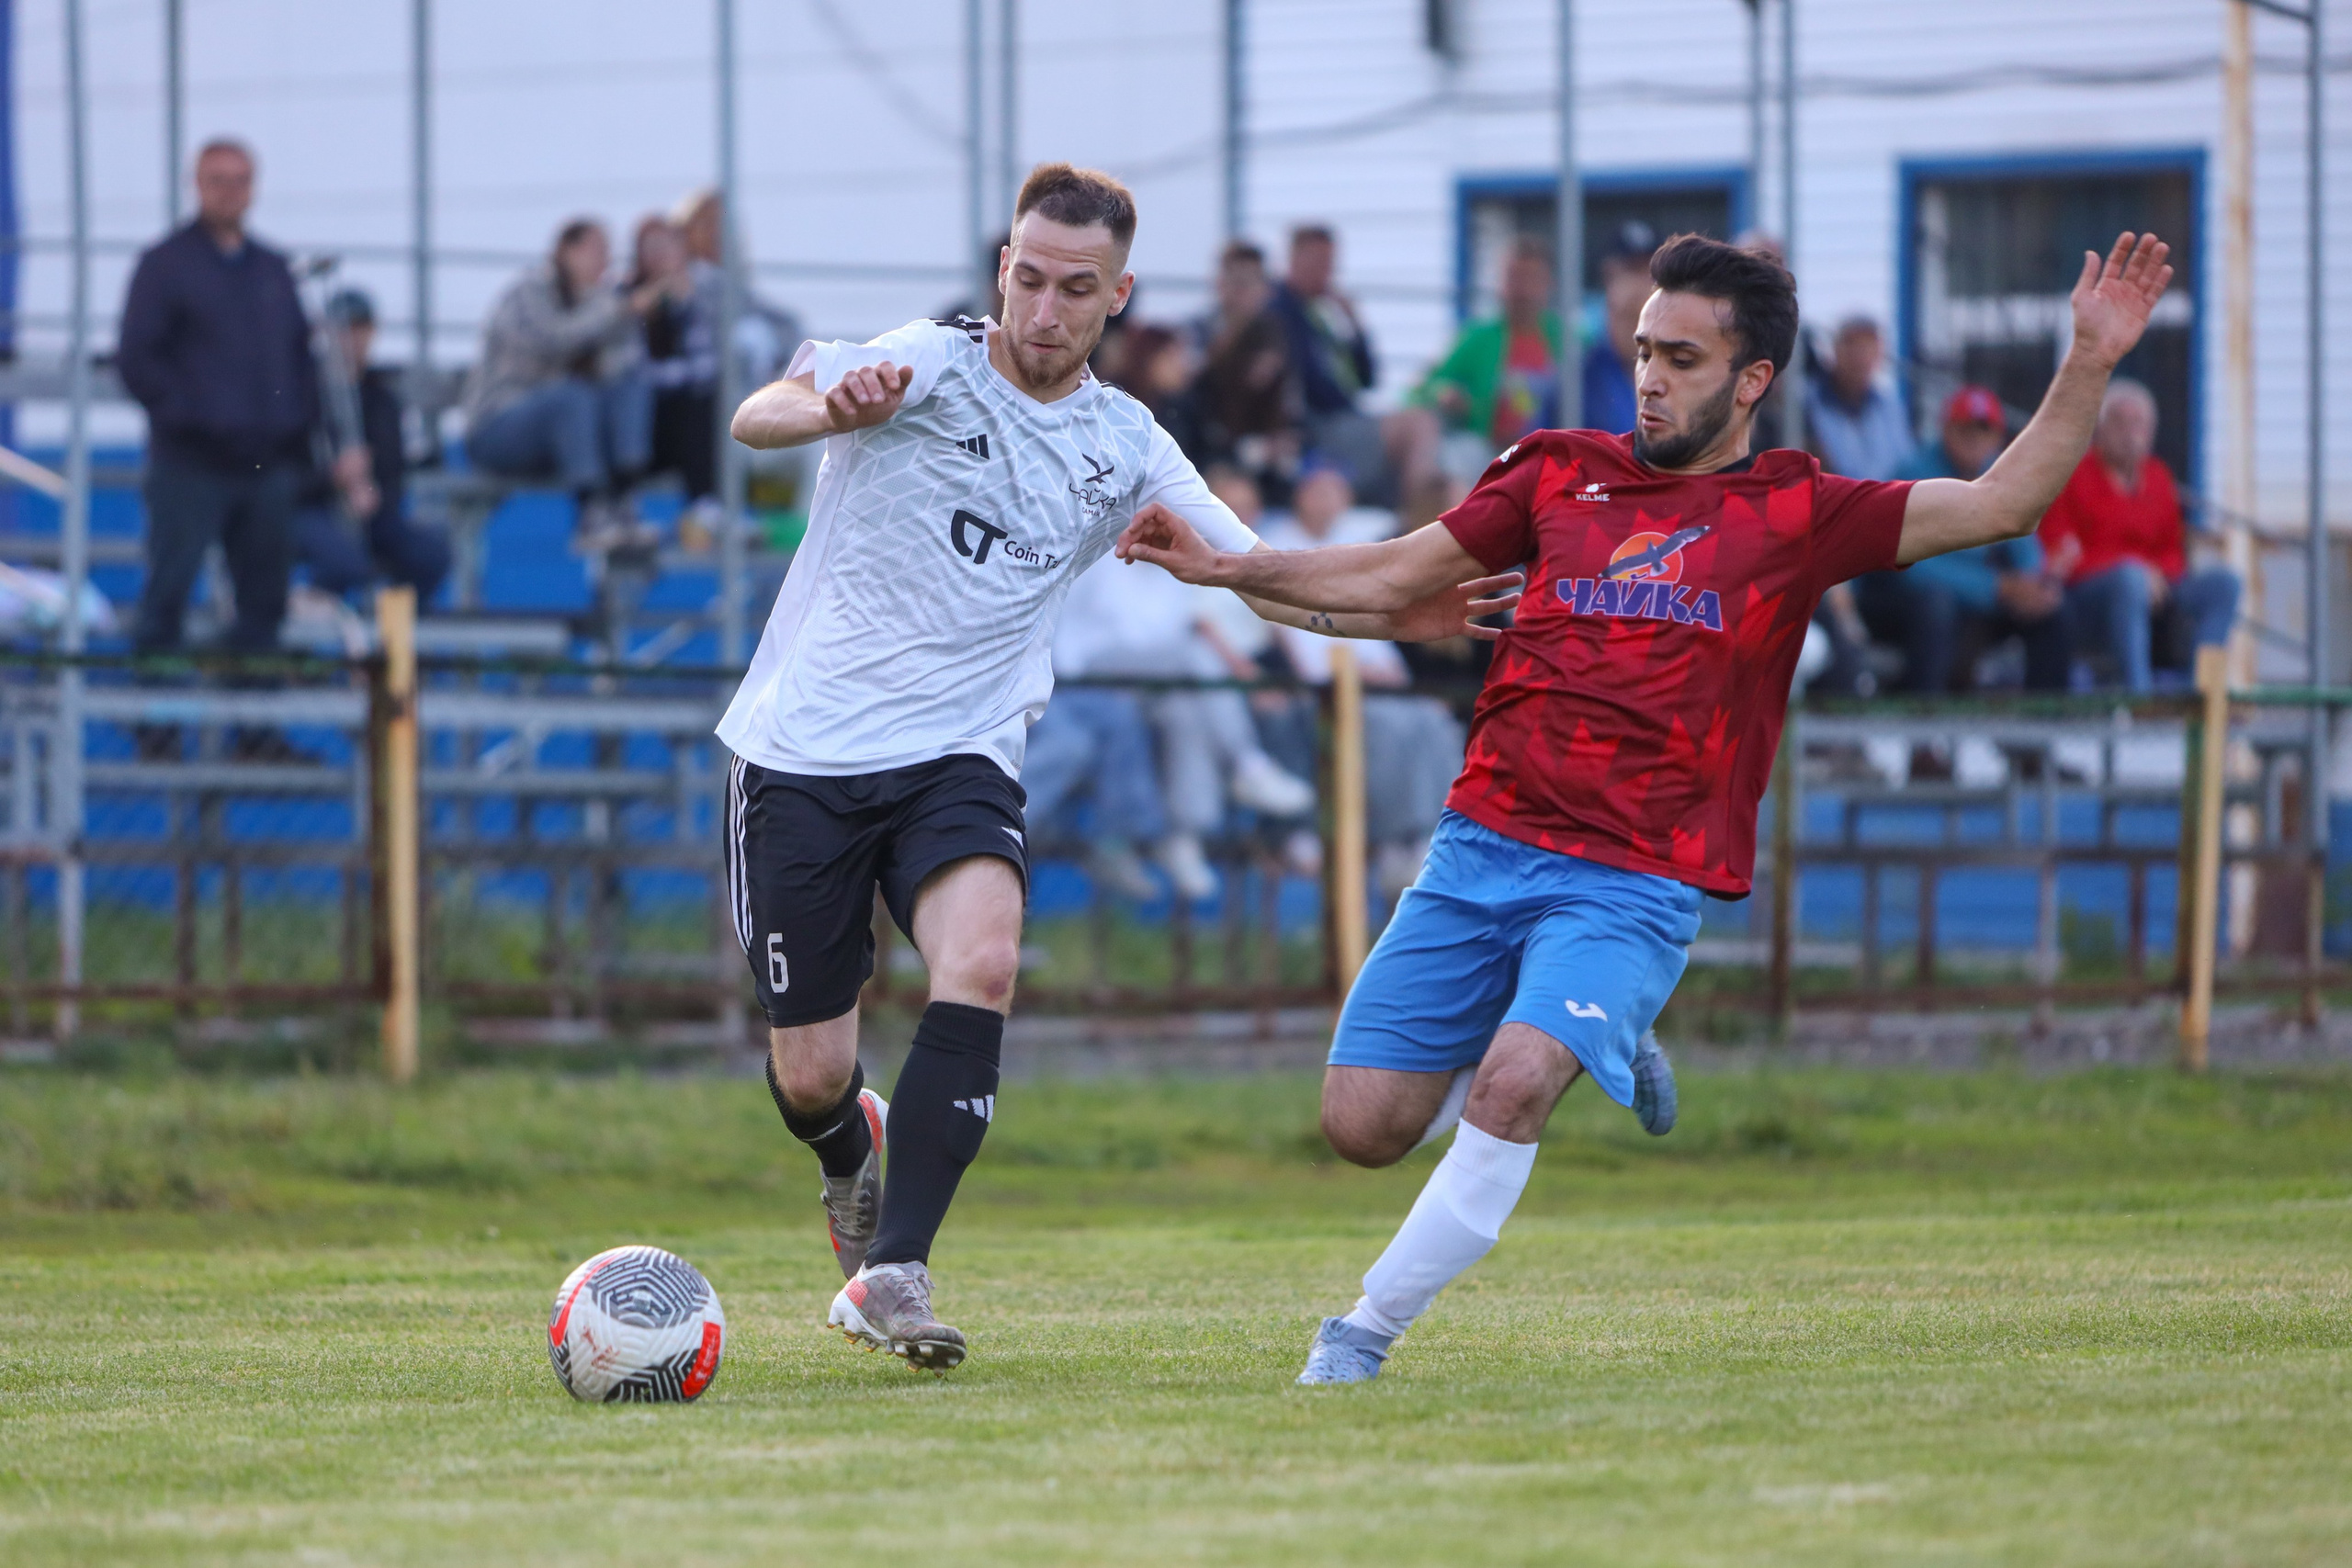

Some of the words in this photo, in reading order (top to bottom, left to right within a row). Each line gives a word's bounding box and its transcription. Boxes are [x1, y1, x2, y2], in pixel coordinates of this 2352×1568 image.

[1575, 493, 1611, 502] KELME
[1004, 540, 1039, 564] Coin
[1556, 572, 1723, 632] ЧАЙКА
[767, 932, 789, 993] 6
